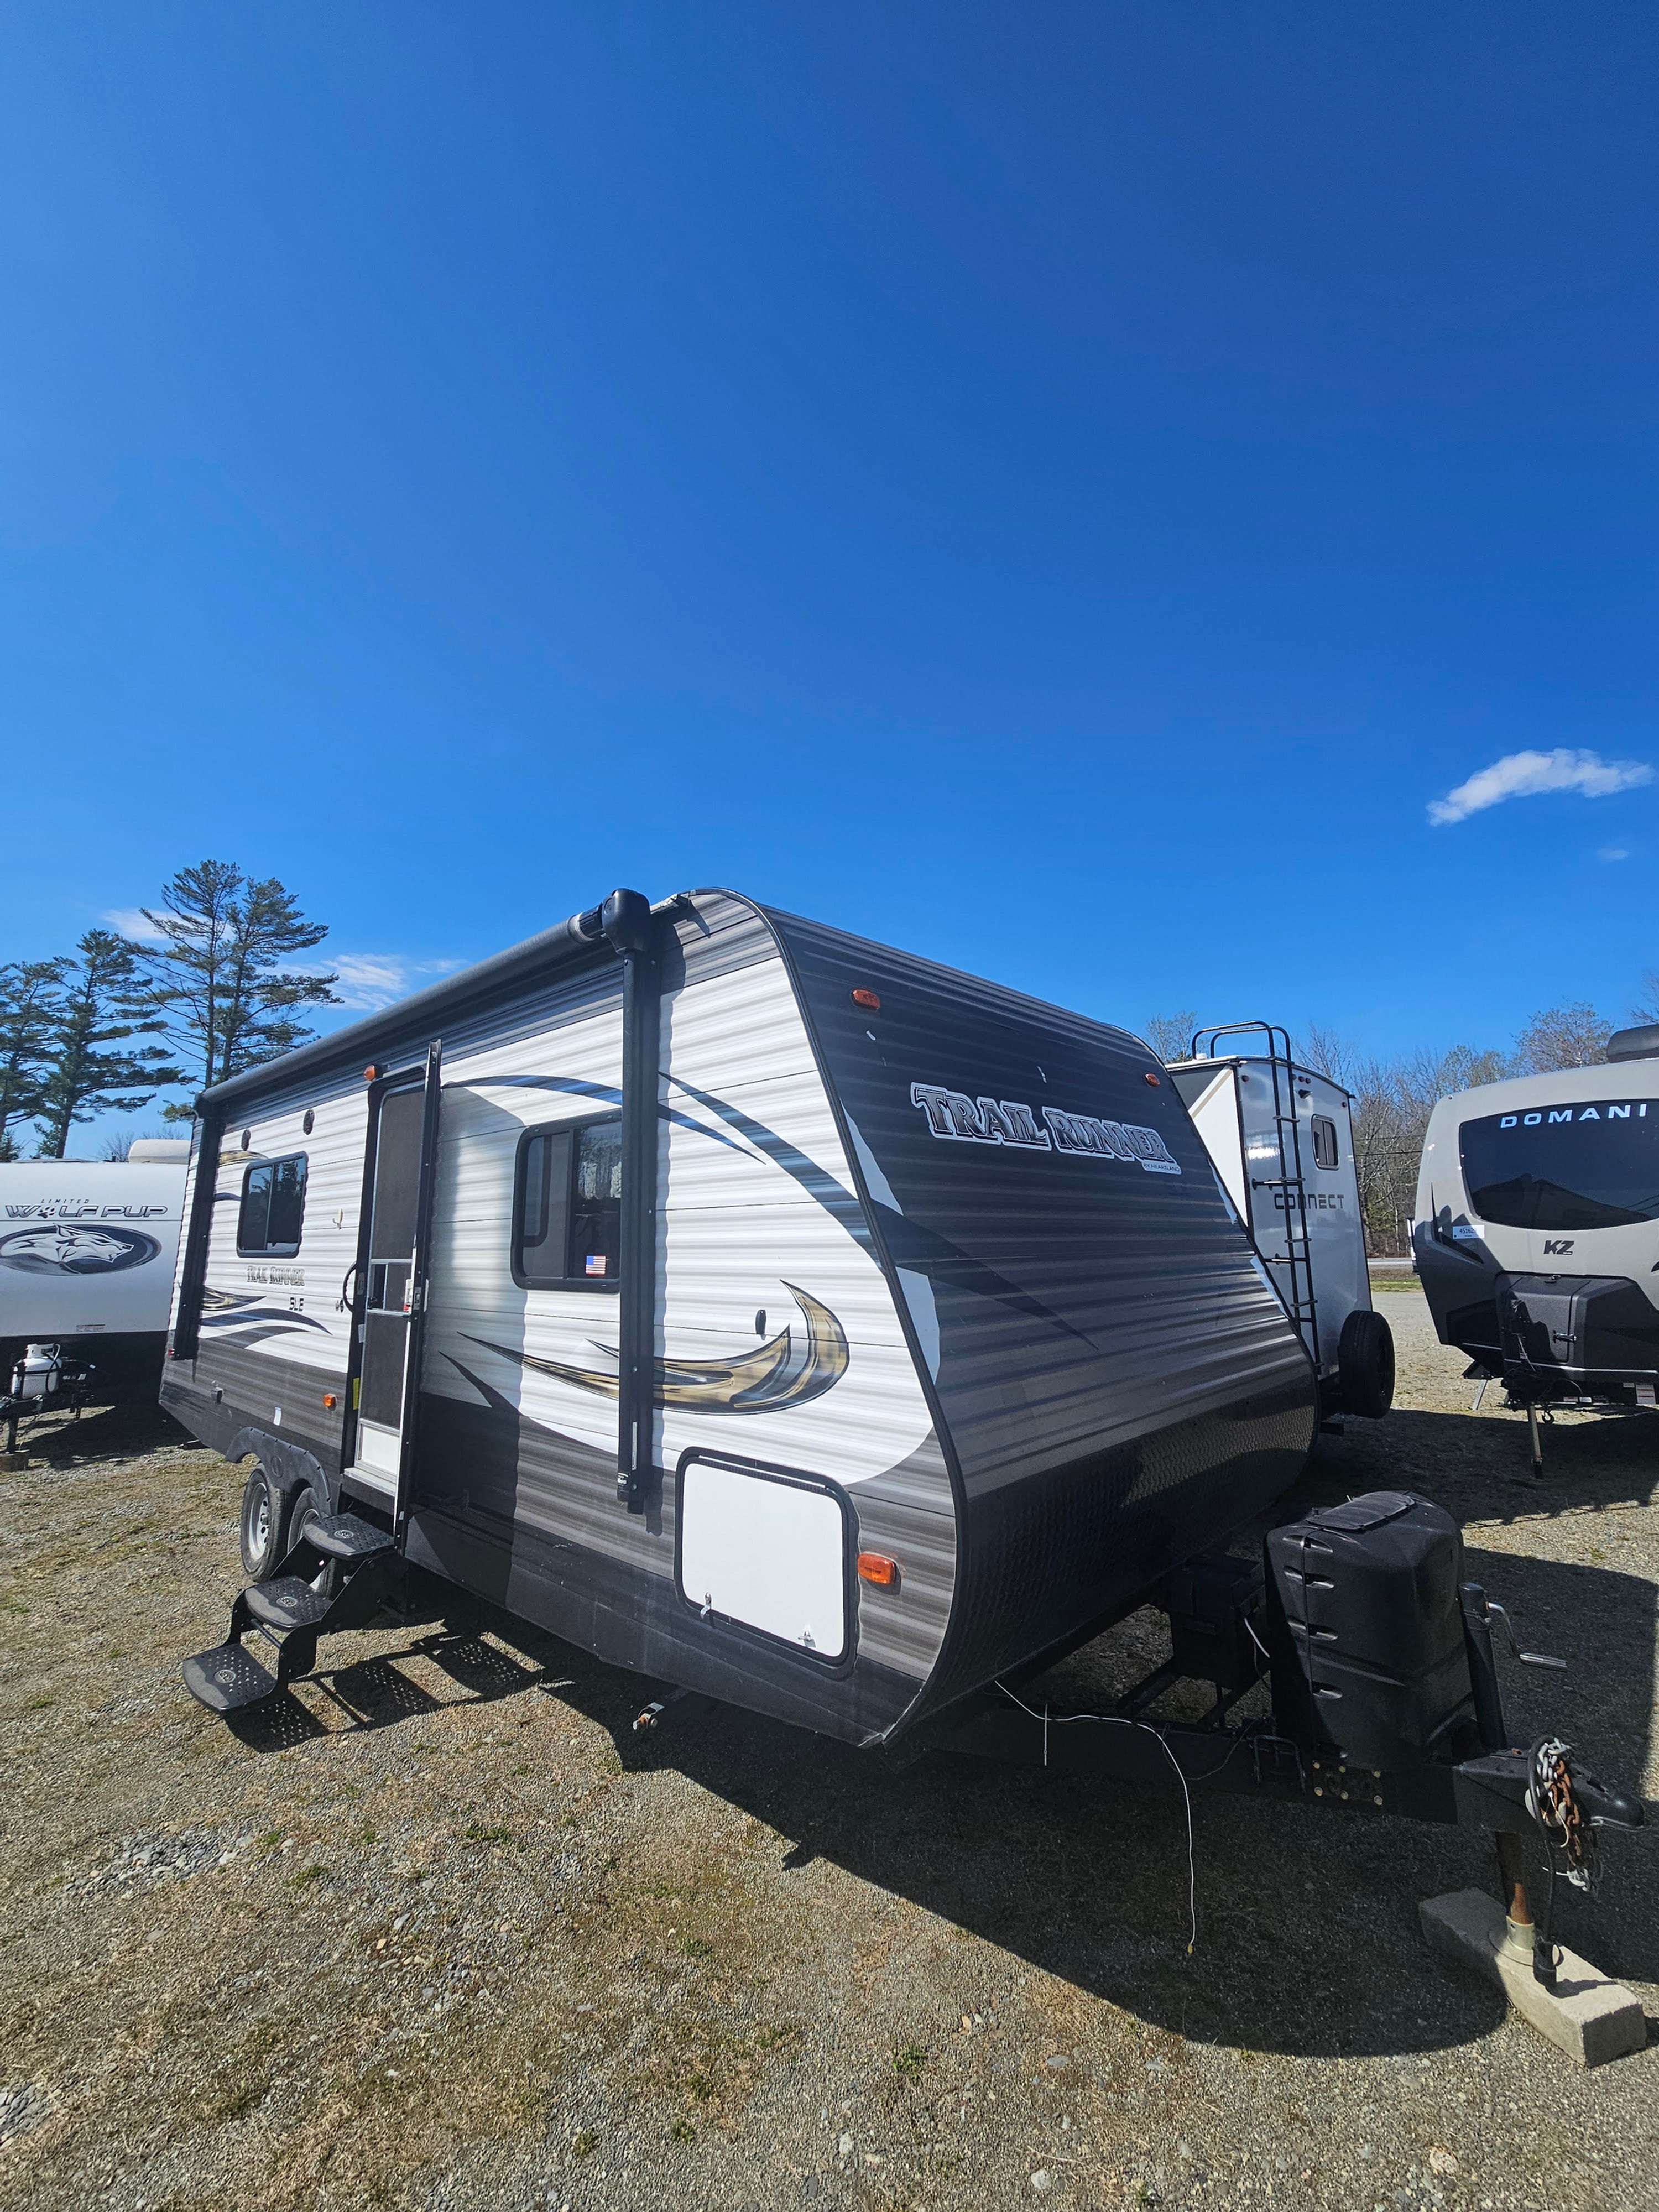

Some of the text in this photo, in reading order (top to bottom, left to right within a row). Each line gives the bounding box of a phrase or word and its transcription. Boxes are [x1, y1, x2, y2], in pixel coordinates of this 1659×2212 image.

[913, 1084, 1176, 1163] TRAIL RUNNER
[1500, 1104, 1647, 1128] DOMANI
[1274, 1193, 1344, 1210] CONNECT
[100, 1205, 168, 1218] PUP
[1543, 1240, 1575, 1256] KZ
[289, 1297, 305, 1312] SLE
